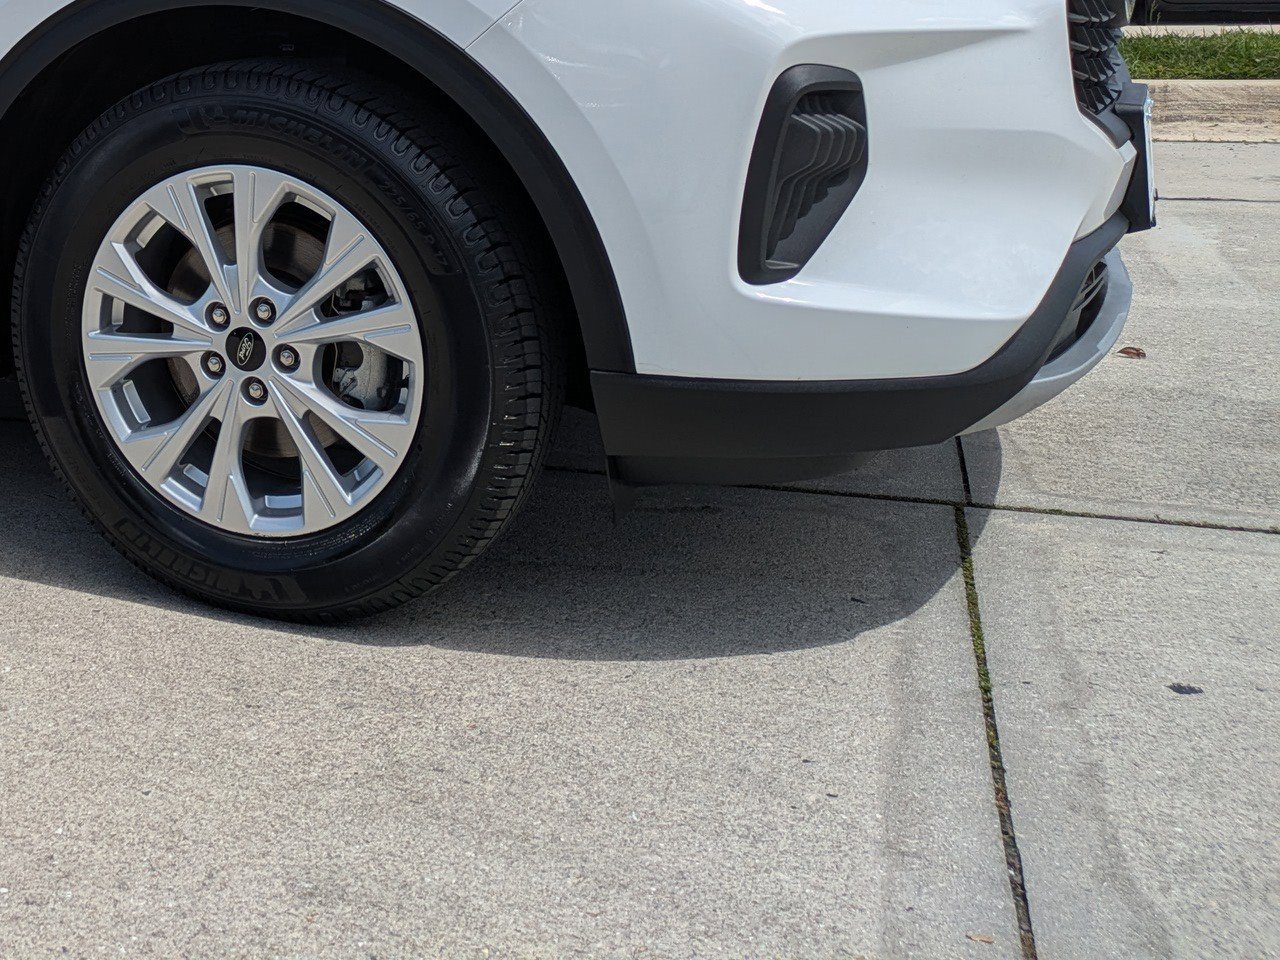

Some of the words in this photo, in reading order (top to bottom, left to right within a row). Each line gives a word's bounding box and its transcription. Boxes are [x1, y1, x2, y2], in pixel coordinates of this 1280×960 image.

[232, 109, 367, 171] MICHELIN
[238, 336, 252, 362] Ford
[117, 518, 240, 595] MICHELIN
